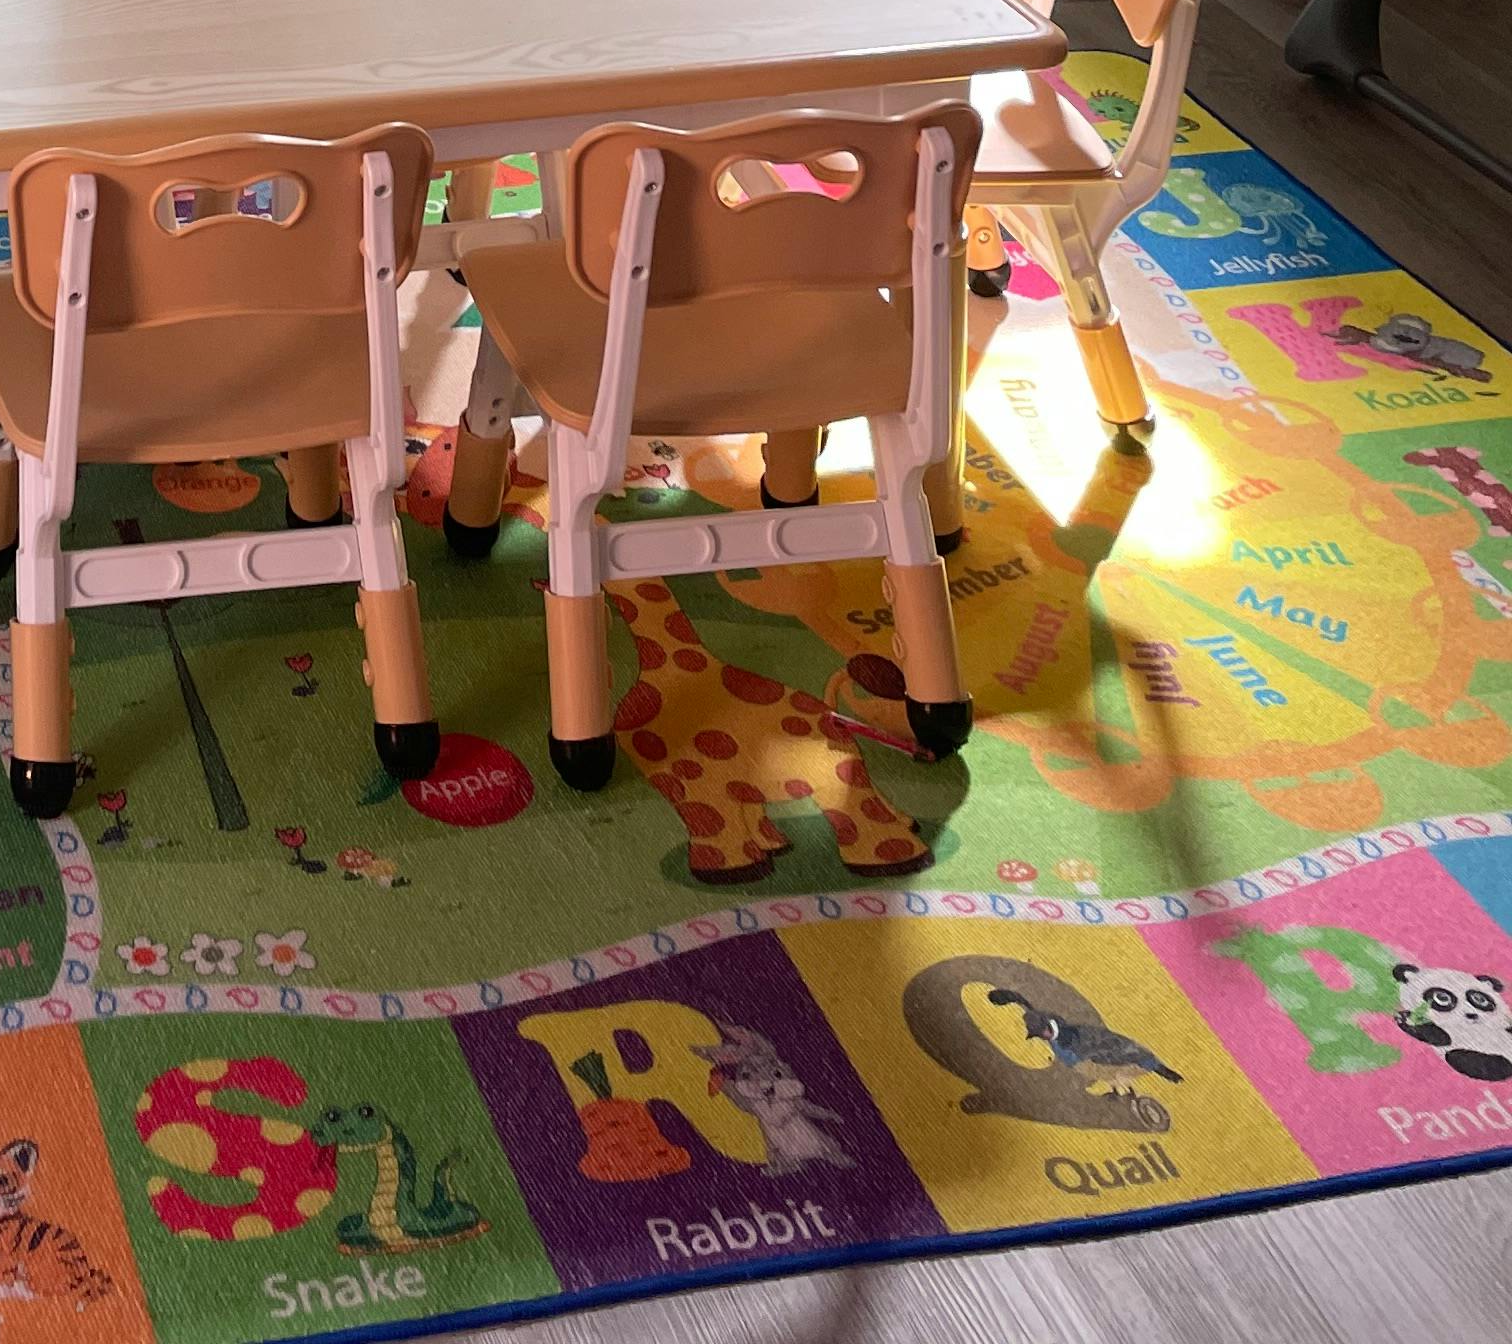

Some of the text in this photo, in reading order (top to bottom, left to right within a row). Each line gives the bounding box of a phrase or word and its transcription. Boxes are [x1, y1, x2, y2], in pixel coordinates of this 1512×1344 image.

[1208, 250, 1329, 279] Jellyfish
[1355, 383, 1471, 412] Koala
[156, 472, 256, 496] Orange
[1213, 474, 1283, 510] arch
[1232, 537, 1354, 571] April
[1237, 585, 1349, 644] May
[993, 602, 1069, 696] August
[1129, 639, 1201, 708] July
[1185, 633, 1289, 709] June
[419, 763, 508, 807] Apple
[1209, 922, 1419, 1075] P
[903, 955, 1172, 1134] Q
[518, 999, 769, 1183] R
[1375, 1088, 1512, 1145] Pand
[136, 1055, 339, 1242] S
[1044, 1141, 1180, 1198] Quail
[646, 1199, 836, 1261] Rabbit
[263, 1258, 426, 1319] Snake
